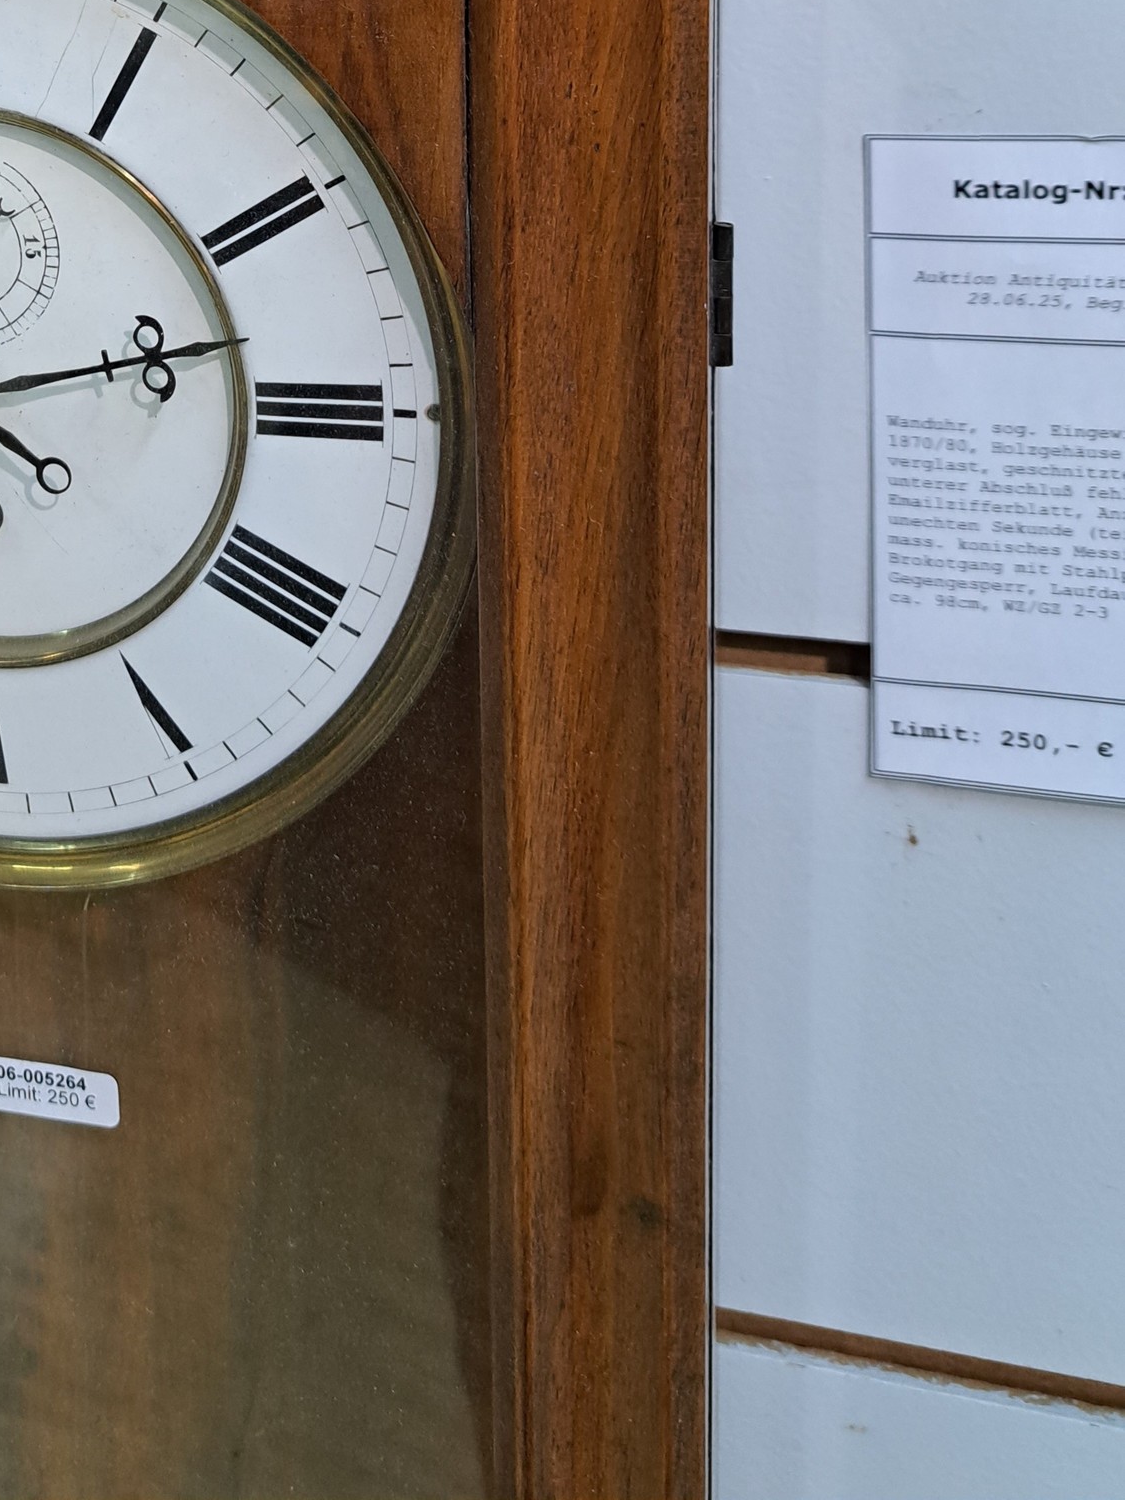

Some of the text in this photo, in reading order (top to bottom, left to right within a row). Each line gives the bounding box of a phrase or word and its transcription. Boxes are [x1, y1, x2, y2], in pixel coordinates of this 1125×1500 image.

[87, 27, 157, 141] I
[200, 173, 328, 269] II
[22, 233, 42, 260] 15
[913, 270, 996, 285] Auktion
[966, 292, 1125, 313] 28.06.25, Beg
[254, 381, 385, 442] III
[886, 414, 1125, 441] Wanduhr, sog. Eingew
[1002, 464, 1125, 480] geschnitzt
[886, 476, 969, 492] unterer
[1087, 486, 1125, 500] feh
[991, 520, 1074, 537] Sekunde
[1089, 526, 1125, 541] (te
[1073, 545, 1125, 561] Mess
[1014, 562, 1050, 576] mit
[889, 592, 921, 605] ca.
[1074, 604, 1109, 619] 2-3
[120, 650, 195, 761] V
[889, 720, 1114, 757] Limit: 250,- €
[47, 1088, 80, 1107] 250
[85, 1094, 96, 1110] €
